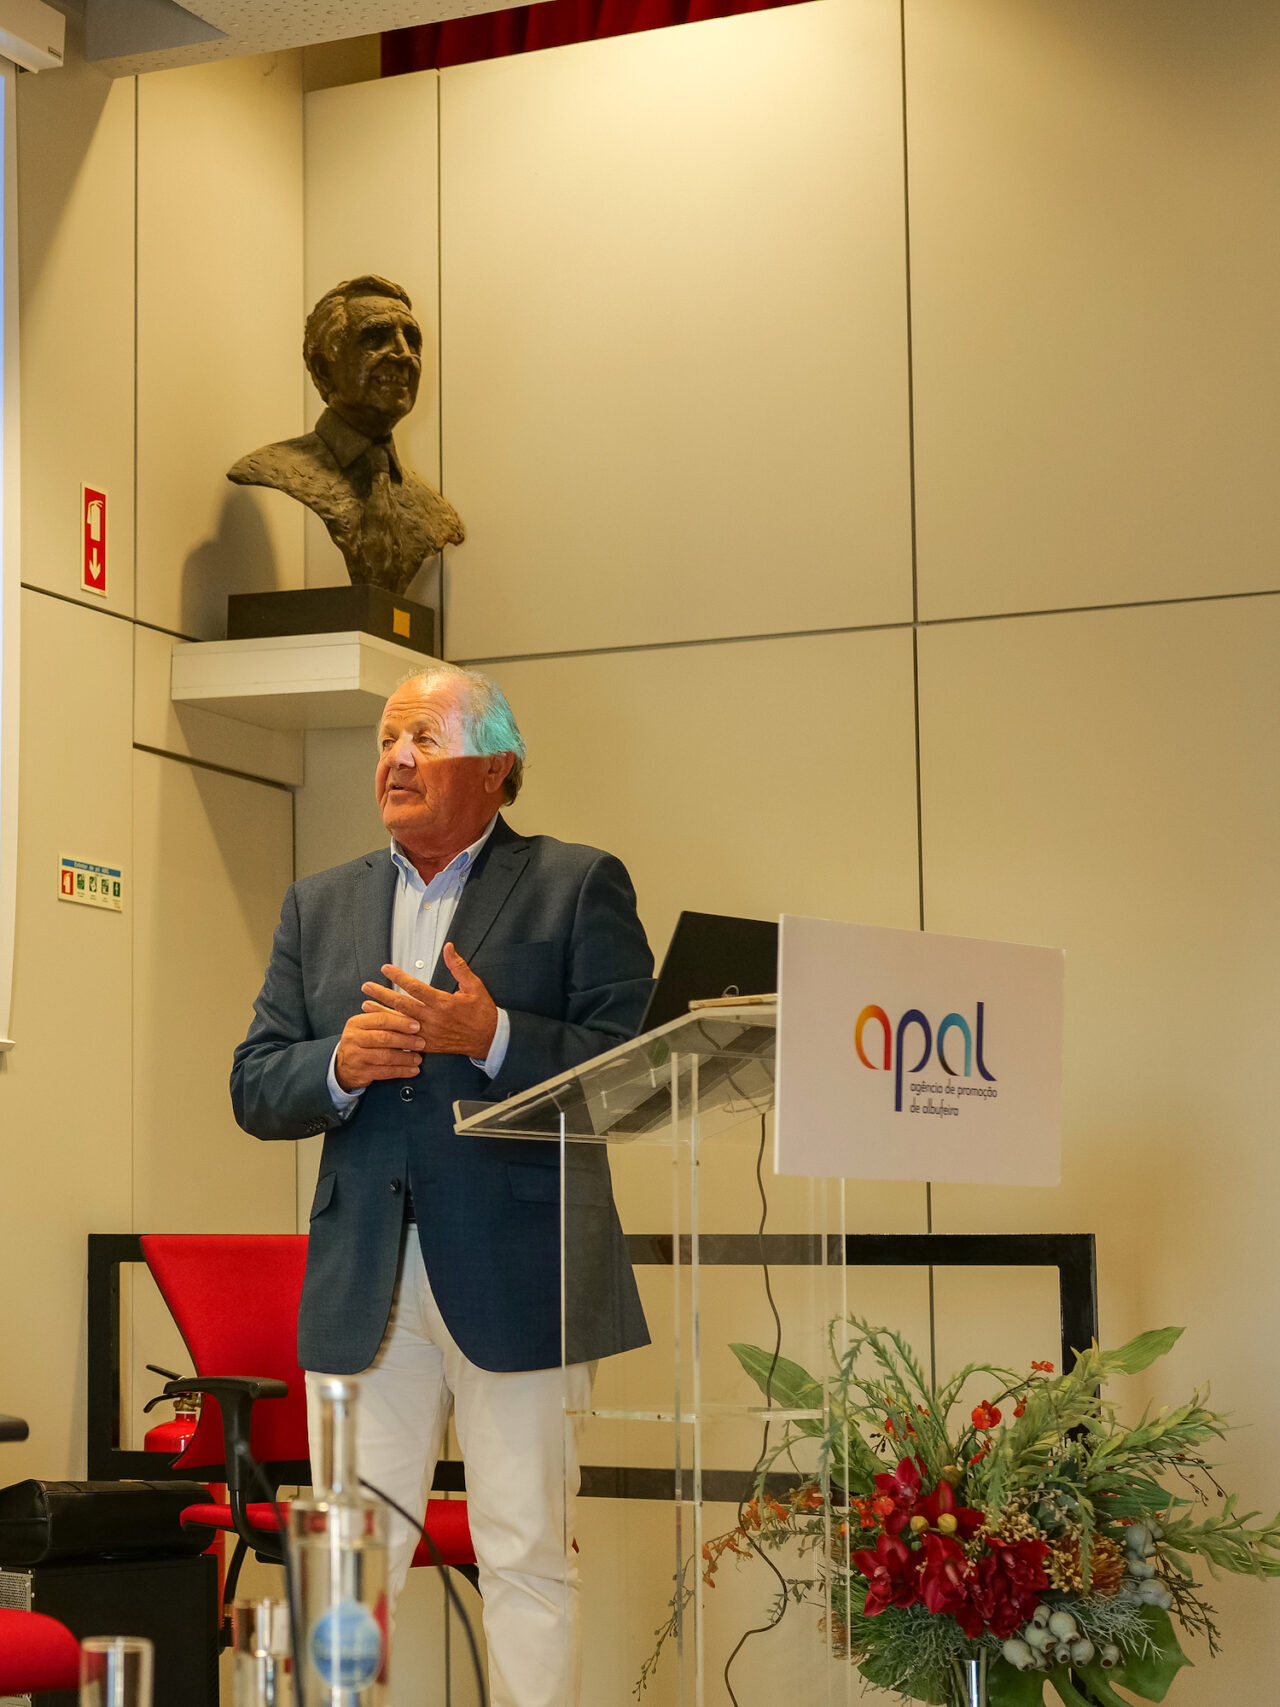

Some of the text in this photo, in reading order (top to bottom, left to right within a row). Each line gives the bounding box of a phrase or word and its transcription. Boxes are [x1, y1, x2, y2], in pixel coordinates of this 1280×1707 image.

[855, 1001, 998, 1112] apal
[910, 1078, 998, 1101] agência de promoção
[910, 1096, 959, 1119] de albufeira
